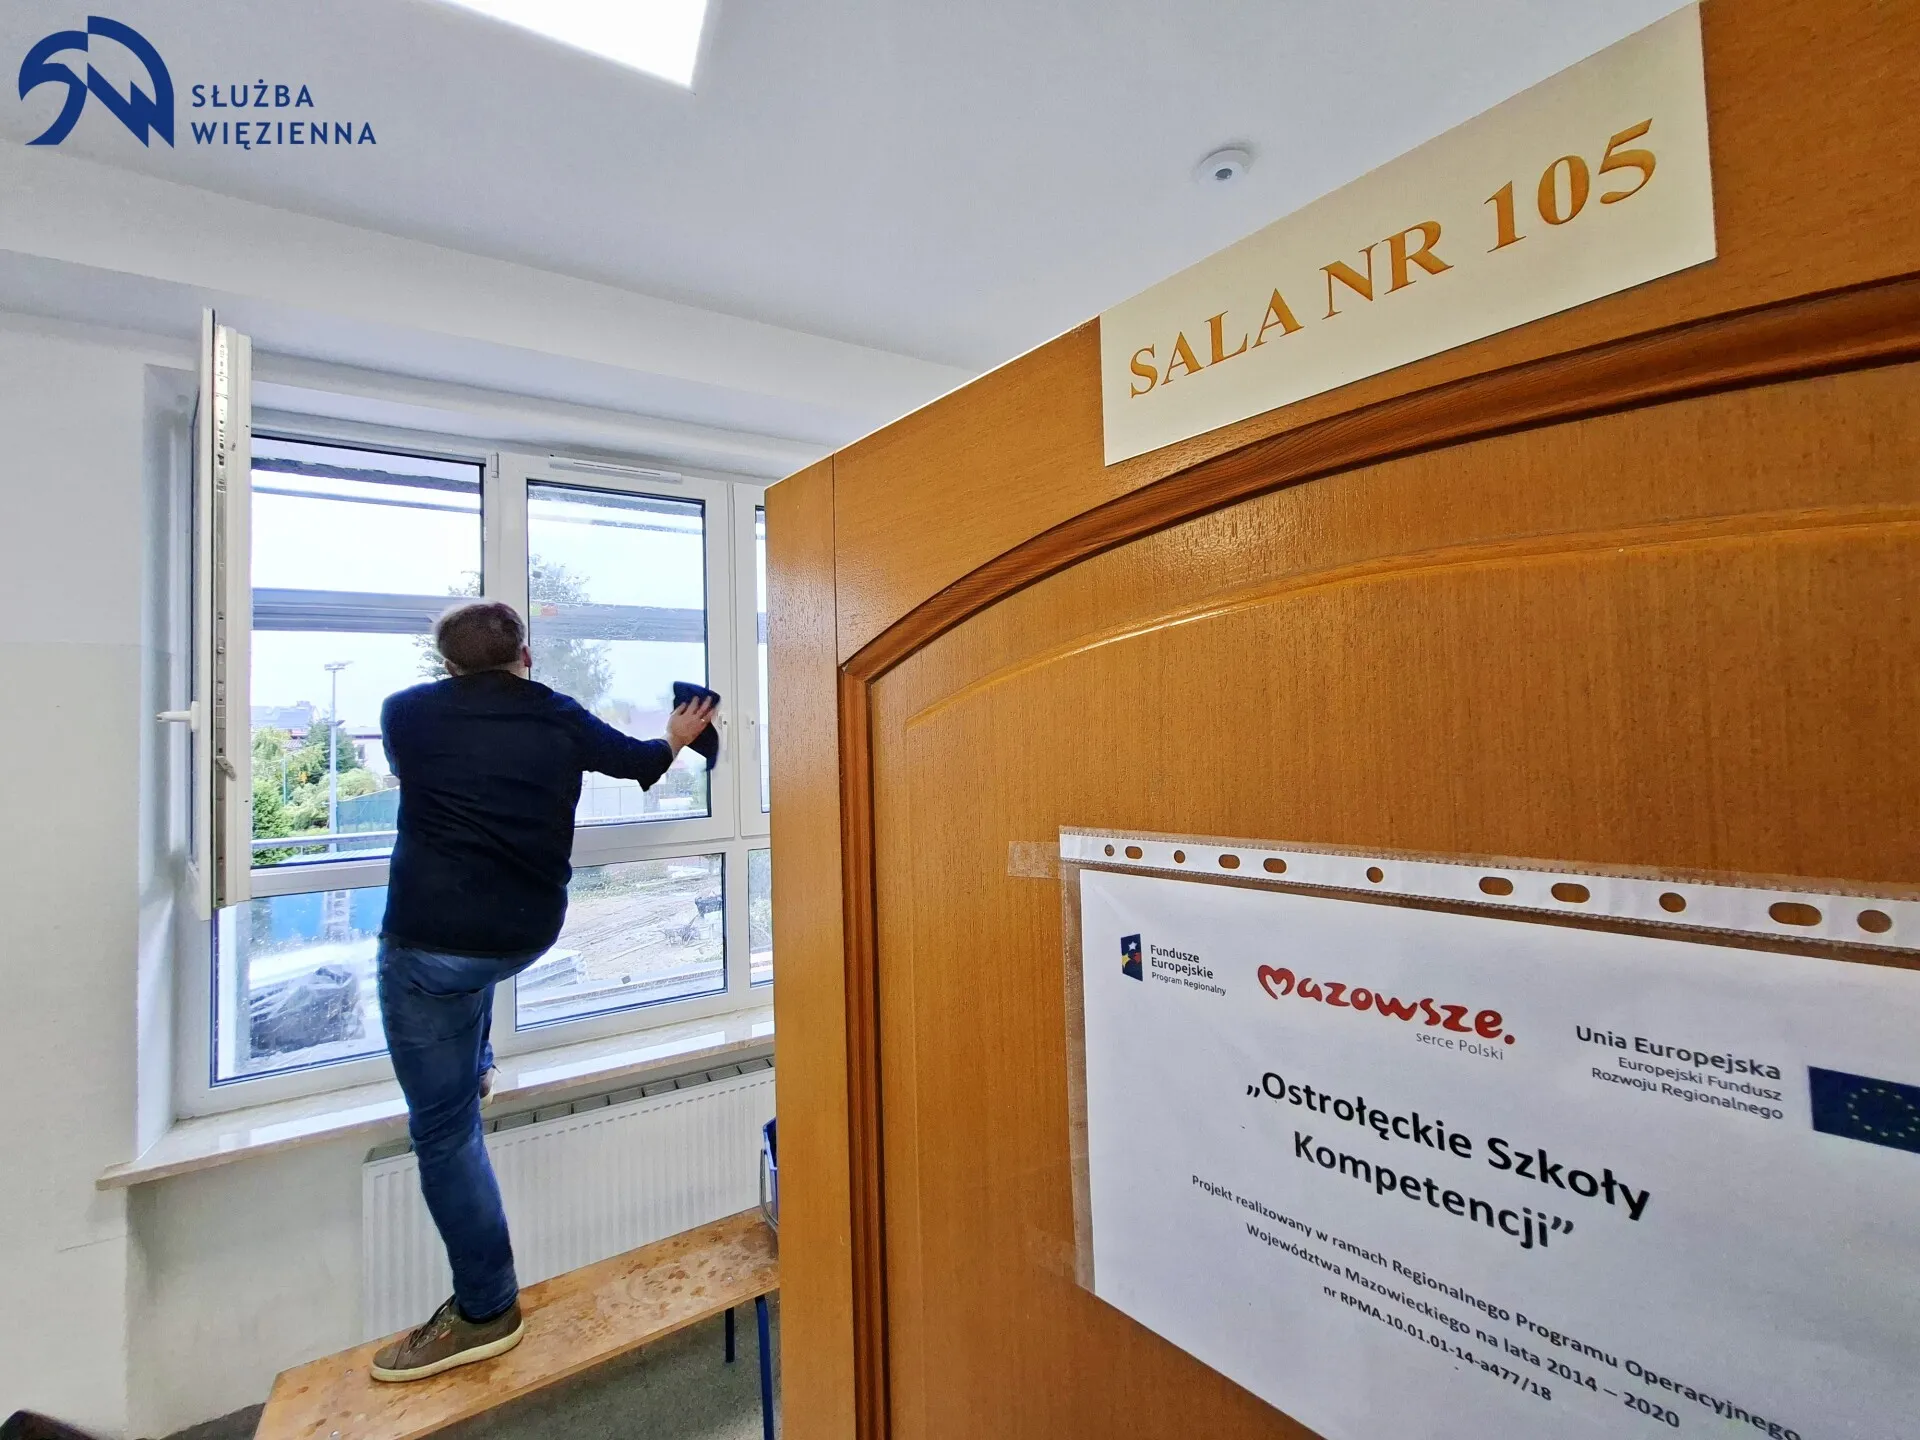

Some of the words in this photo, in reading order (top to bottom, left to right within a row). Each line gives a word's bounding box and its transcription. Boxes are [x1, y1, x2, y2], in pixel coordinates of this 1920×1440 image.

[1130, 288, 1304, 399] SALA
[1319, 219, 1454, 320] NR
[1484, 117, 1657, 253] 105
[1150, 944, 1200, 963] Fundusze
[1151, 957, 1214, 979] Europejskie
[1152, 971, 1182, 986] Program
[1184, 979, 1227, 997] Regionalny
[1416, 1031, 1454, 1049] serce
[1459, 1039, 1504, 1060] Polski
[1576, 1025, 1627, 1049] Unia
[1635, 1037, 1781, 1080] Europejska
[1592, 1067, 1657, 1092] Rozwoju
[1661, 1082, 1784, 1120] Regionalnego
[1618, 1056, 1702, 1084] Europejski
[1708, 1075, 1783, 1101] Fundusz
[1247, 1072, 1473, 1159] „Ostrołęckie
[1487, 1137, 1650, 1221] Szkoły
[1293, 1131, 1575, 1249] Kompetencji”
[1192, 1175, 1233, 1202] Projekt
[1236, 1194, 1312, 1237] realizowany
[1316, 1230, 1329, 1242] w
[1332, 1236, 1388, 1268] ramach
[1392, 1259, 1510, 1322] Regionalnego
[1516, 1312, 1618, 1369] Programu
[1625, 1360, 1801, 1440] Operacyjnego
[1246, 1222, 1342, 1276] Województwa
[1345, 1267, 1470, 1335] Mazowieckiego
[1476, 1327, 1499, 1348] na
[1504, 1337, 1541, 1368] lata
[1547, 1358, 1598, 1393] 2014
[1624, 1392, 1680, 1429] 2020
[1323, 1285, 1337, 1298] nr
[1340, 1293, 1552, 1401] RPMA.10.01.01-14-a477/18
